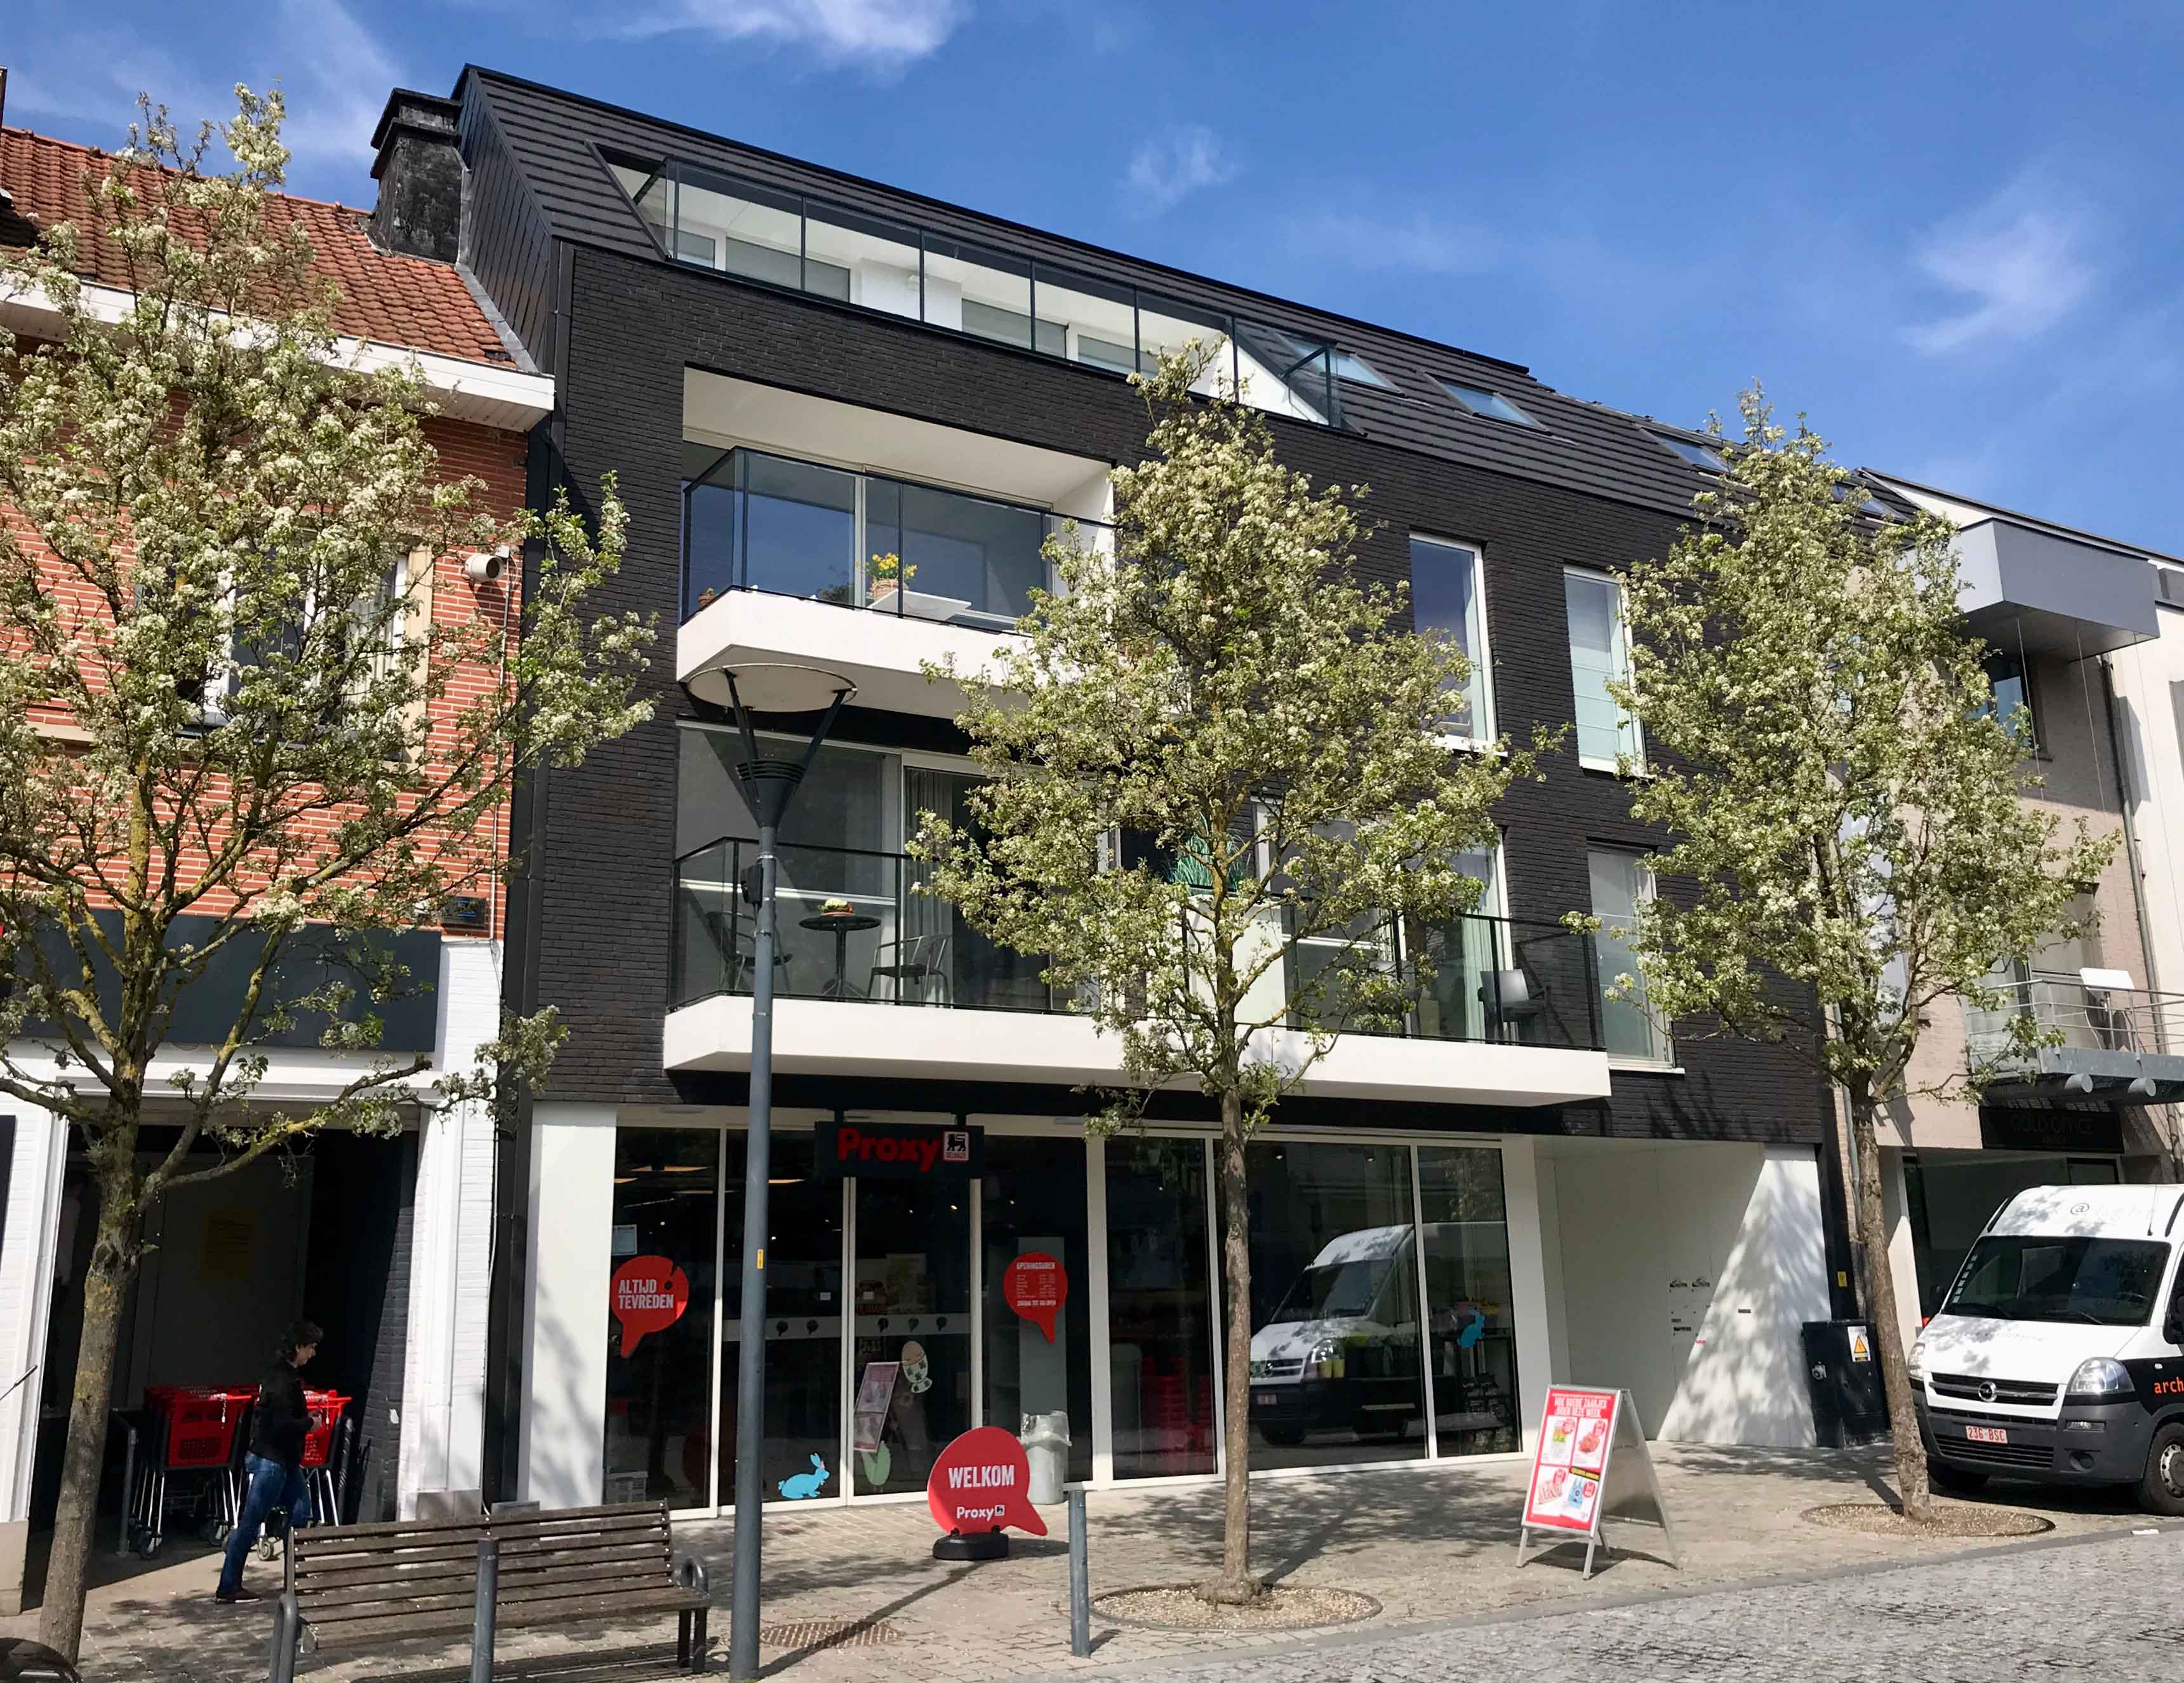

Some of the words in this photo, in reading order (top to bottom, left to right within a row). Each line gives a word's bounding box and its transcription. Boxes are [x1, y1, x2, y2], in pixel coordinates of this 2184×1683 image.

[838, 1128, 939, 1172] Proxy
[619, 1279, 657, 1293] ALTIJD
[619, 1294, 674, 1310] TEVREDEN
[1969, 1427, 1983, 1439] 236
[1988, 1428, 2006, 1442] BSC
[949, 1465, 1015, 1488] WELKOM
[957, 1506, 994, 1522] Proxy
